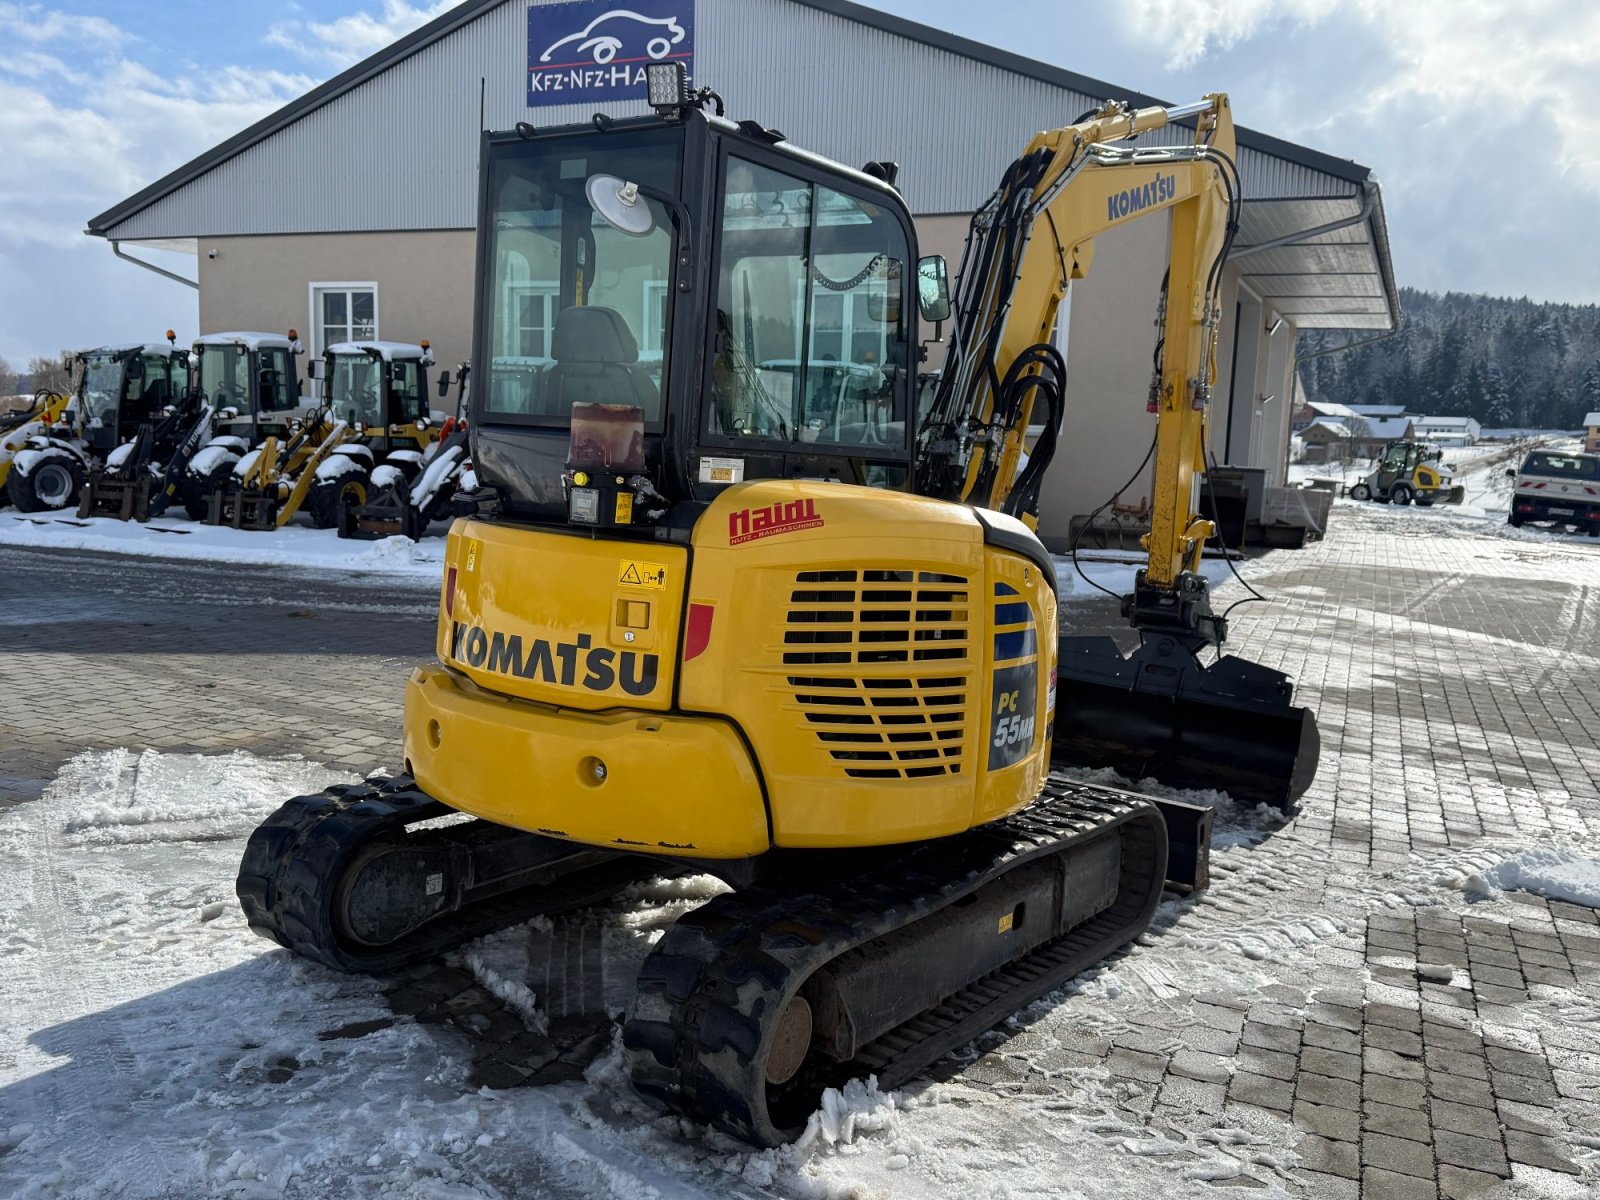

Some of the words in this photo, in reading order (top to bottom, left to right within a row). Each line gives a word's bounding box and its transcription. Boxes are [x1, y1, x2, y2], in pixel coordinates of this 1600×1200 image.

[1108, 172, 1175, 221] KOMATSU
[731, 534, 752, 545] NUTZ
[758, 520, 823, 538] BAUMASCHINEN
[451, 621, 659, 696] KOMATSU
[997, 690, 1019, 715] PC
